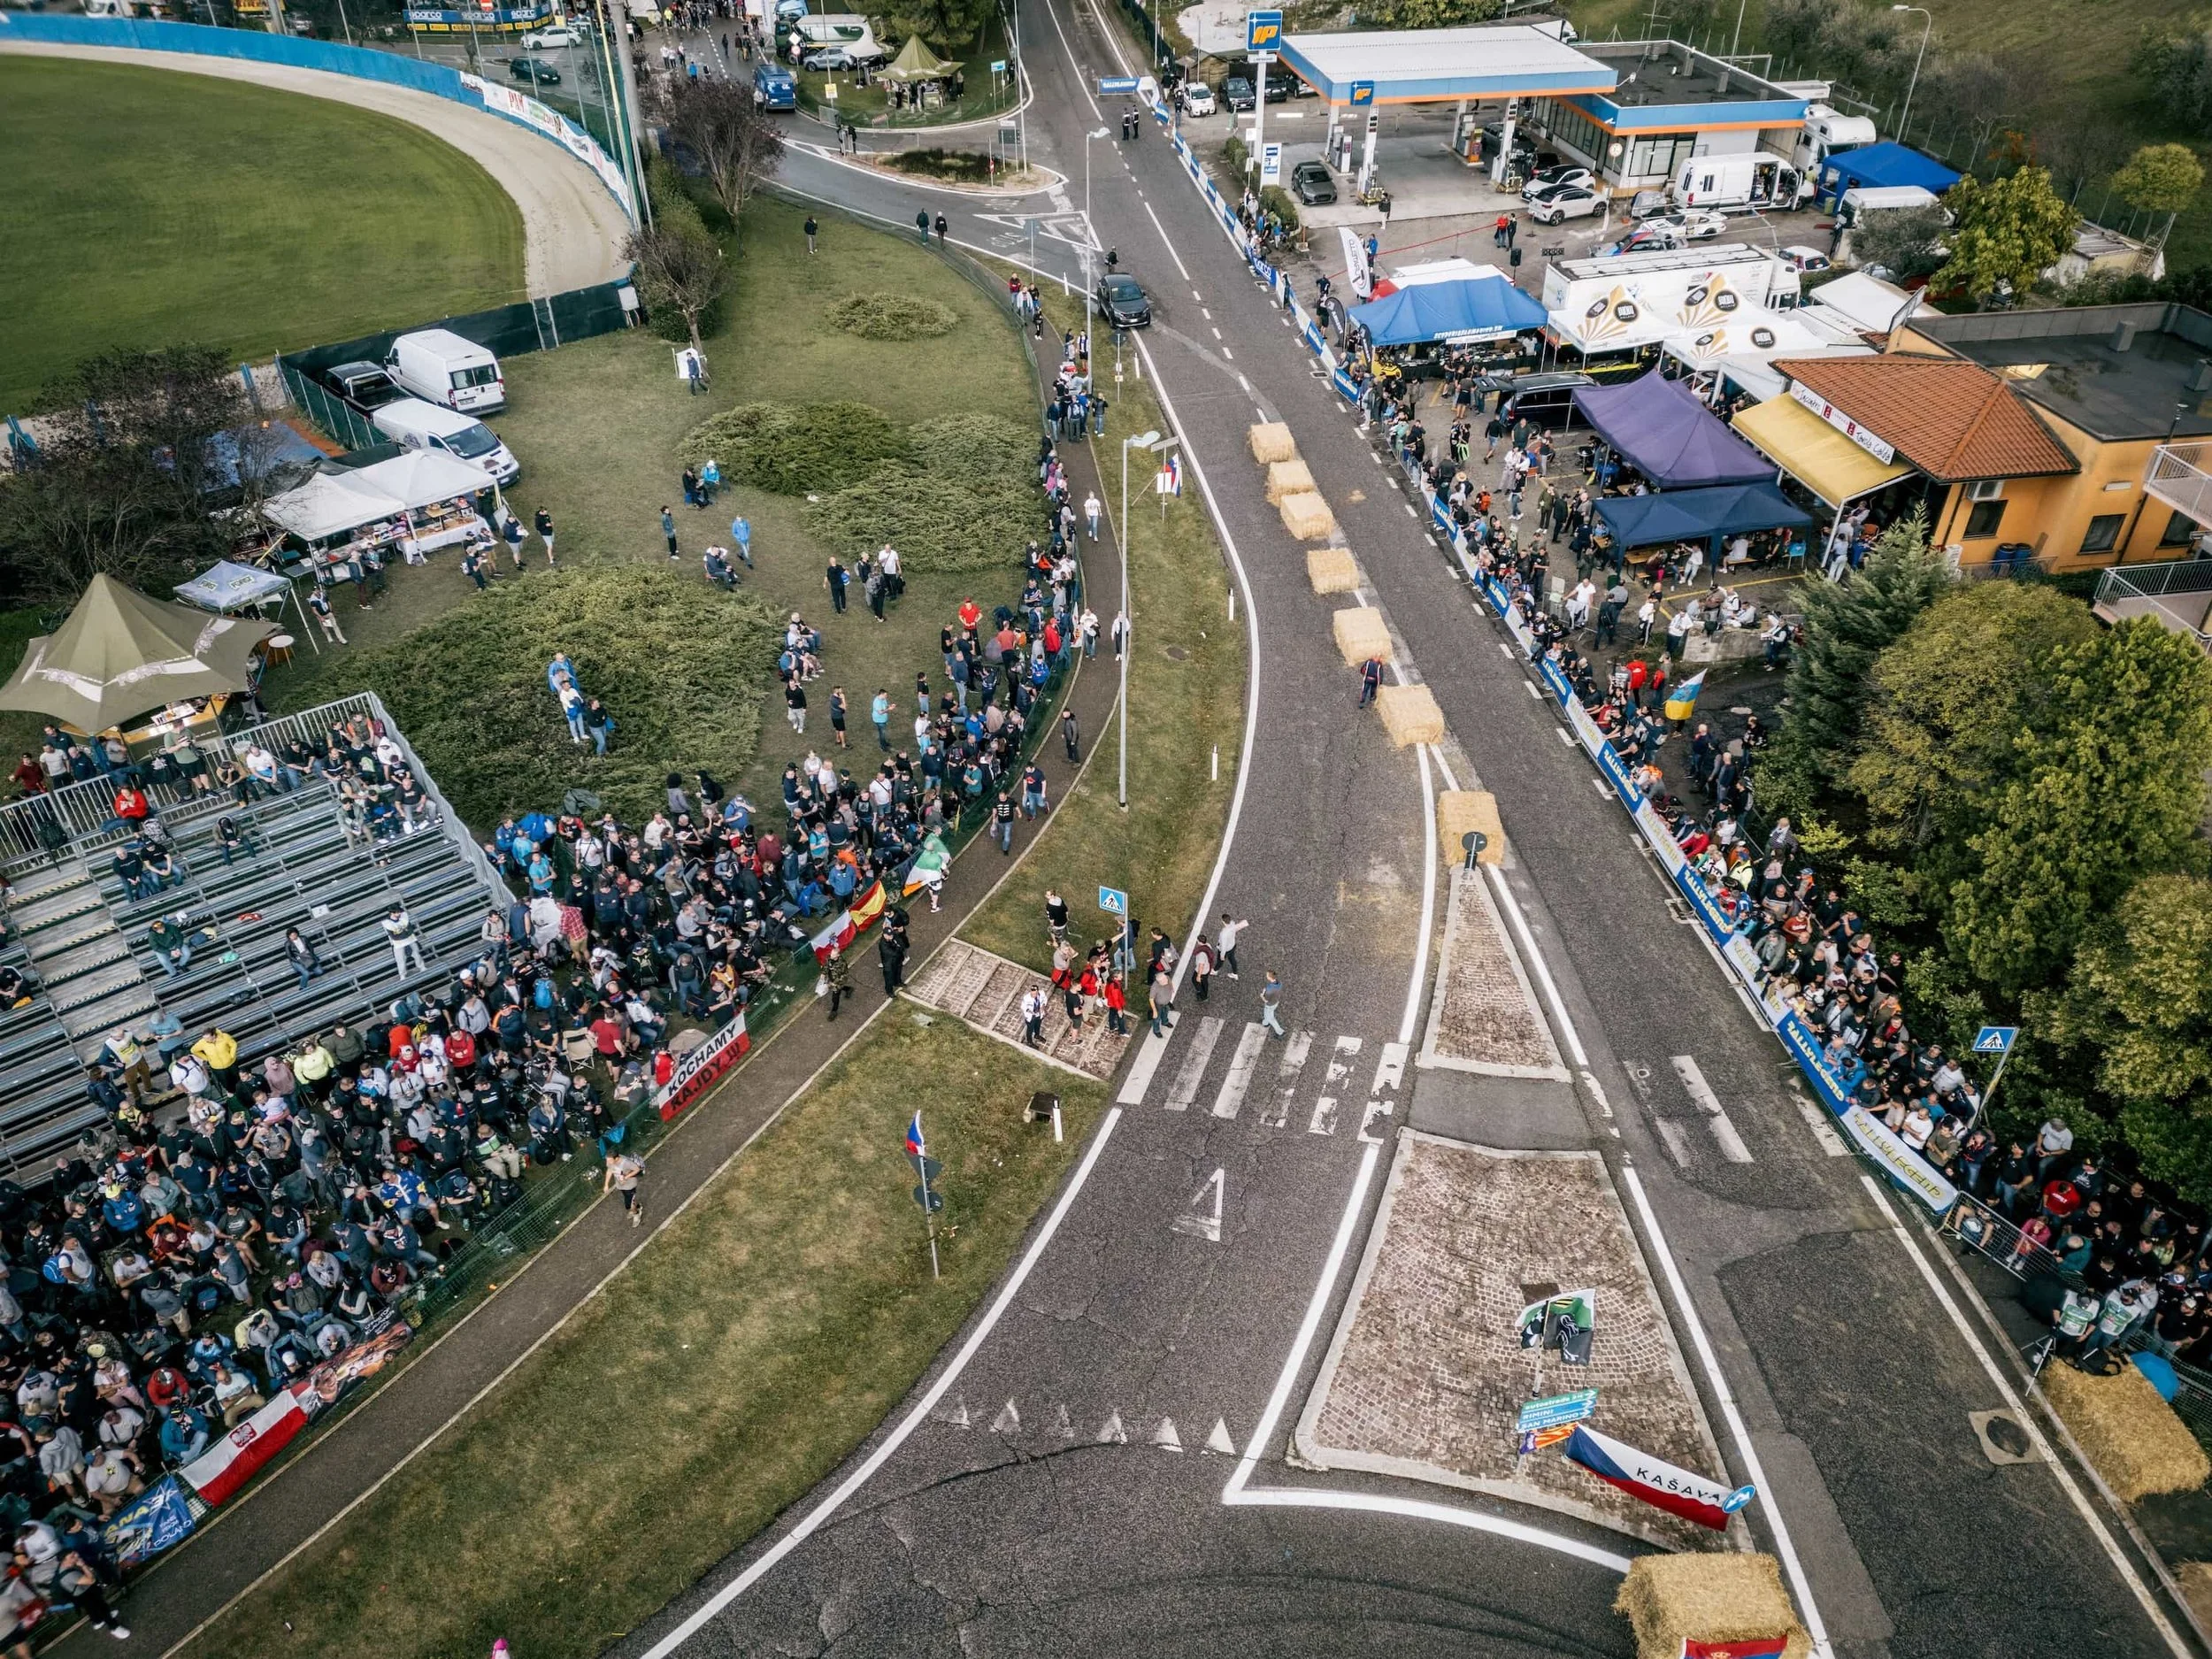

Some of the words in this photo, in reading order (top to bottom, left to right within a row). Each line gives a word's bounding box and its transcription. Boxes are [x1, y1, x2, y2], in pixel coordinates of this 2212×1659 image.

[1252, 26, 1279, 44] IP
[1354, 88, 1371, 100] IP
[668, 1023, 736, 1096] KOCHAMY
[1787, 1020, 1845, 1102] RALLYLEGEND
[1854, 1112, 1942, 1200] RALLYLEGEND
[1521, 1420, 1541, 1430] SAN
[1543, 1412, 1579, 1425] MARINO
[1523, 1409, 1555, 1420] RIMINI
[1637, 1467, 1720, 1502] KAŠAVA
[153, 1520, 192, 1548] POLAND
